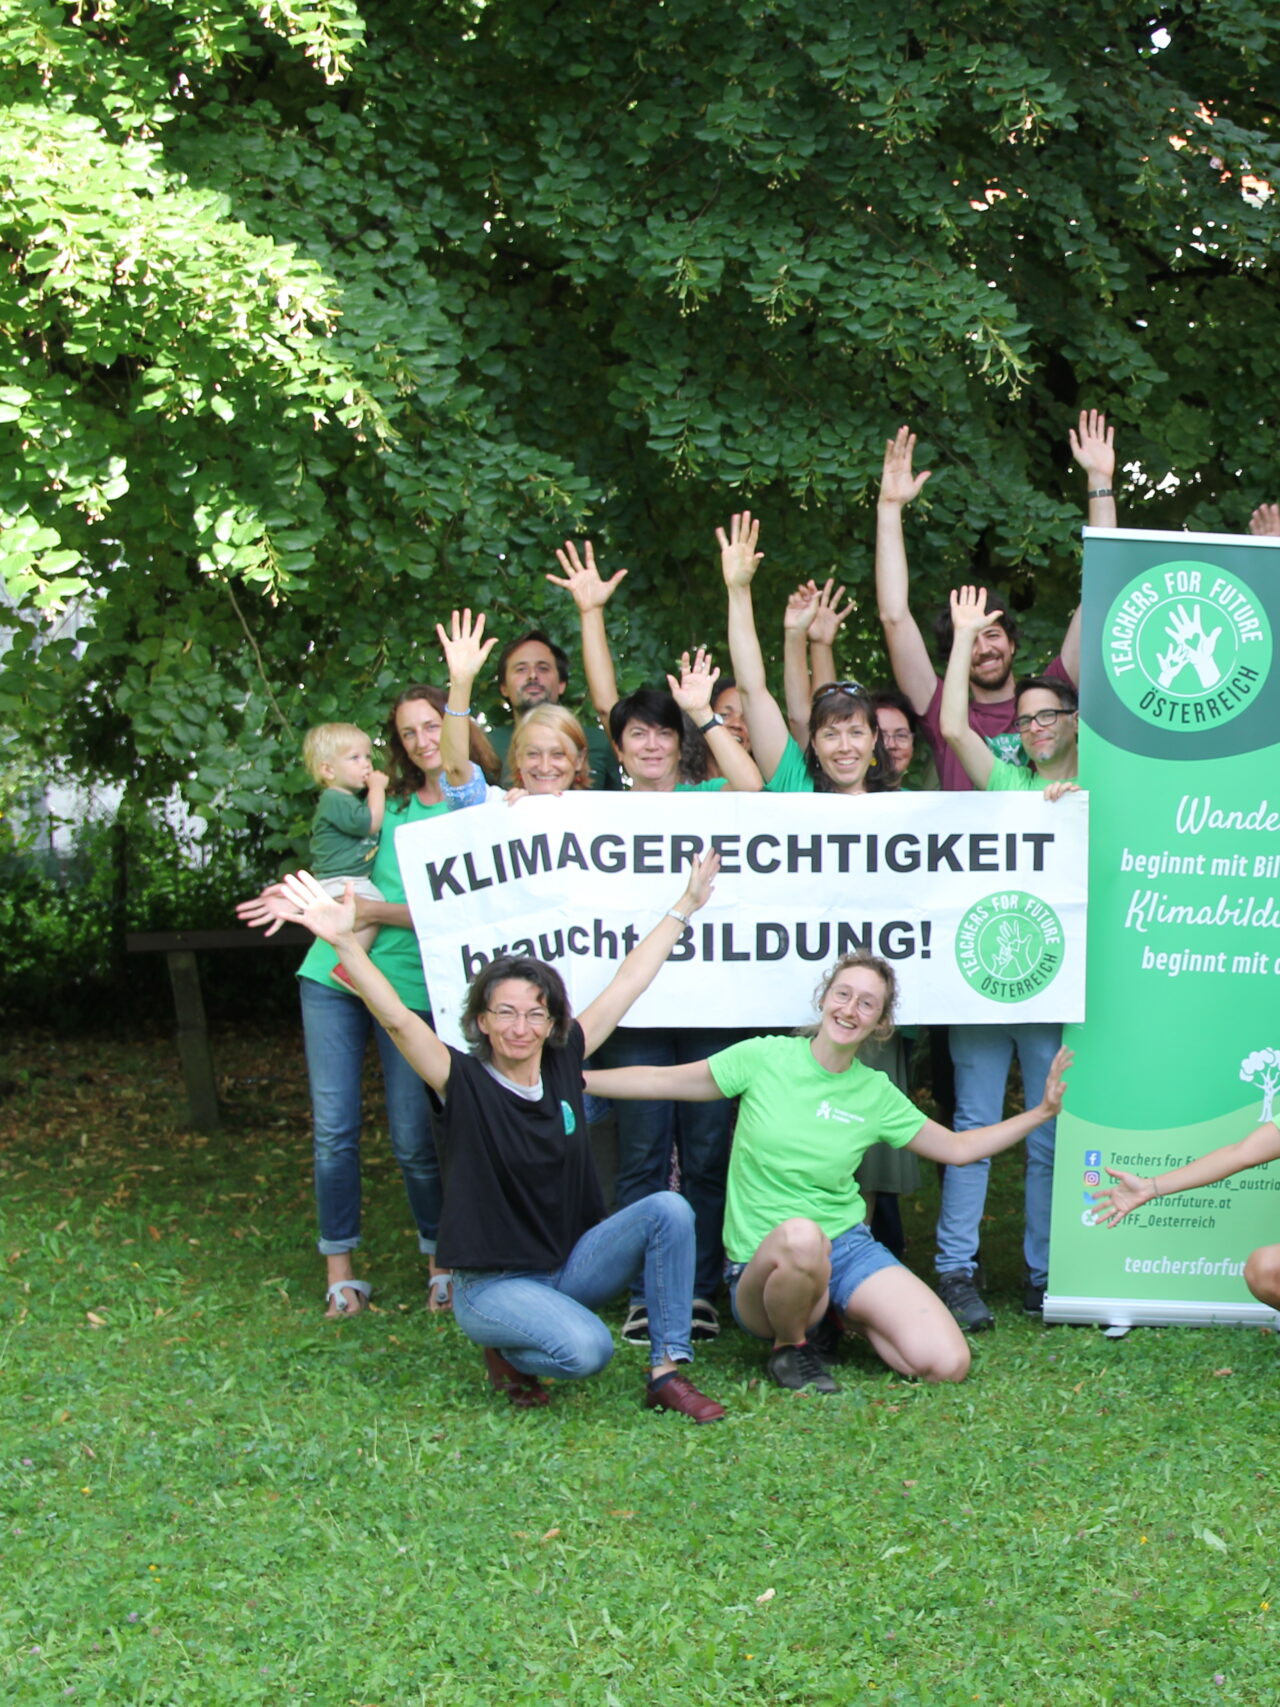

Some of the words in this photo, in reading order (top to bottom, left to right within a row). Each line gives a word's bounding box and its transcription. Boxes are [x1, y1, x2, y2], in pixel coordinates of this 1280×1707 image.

[1110, 582, 1159, 677] TEACHERS
[1164, 570, 1201, 594] FOR
[1208, 578, 1263, 644] FUTURE
[1139, 665, 1259, 724] ÖSTERREICH
[425, 832, 1055, 902] KLIMAGERECHTIGKEIT
[1121, 848, 1205, 879] beginnt
[1210, 854, 1248, 877] mit
[665, 921, 932, 962] BILDUNG!
[959, 905, 989, 978] TEACHERS
[991, 894, 1019, 912] FOR
[1024, 899, 1060, 945] FUTURE
[1141, 945, 1226, 977] beginnt
[1232, 951, 1268, 975] mit
[1110, 1152, 1162, 1166] Teachers
[1164, 1154, 1183, 1167] for
[1124, 1256, 1246, 1276] teachersforfut
